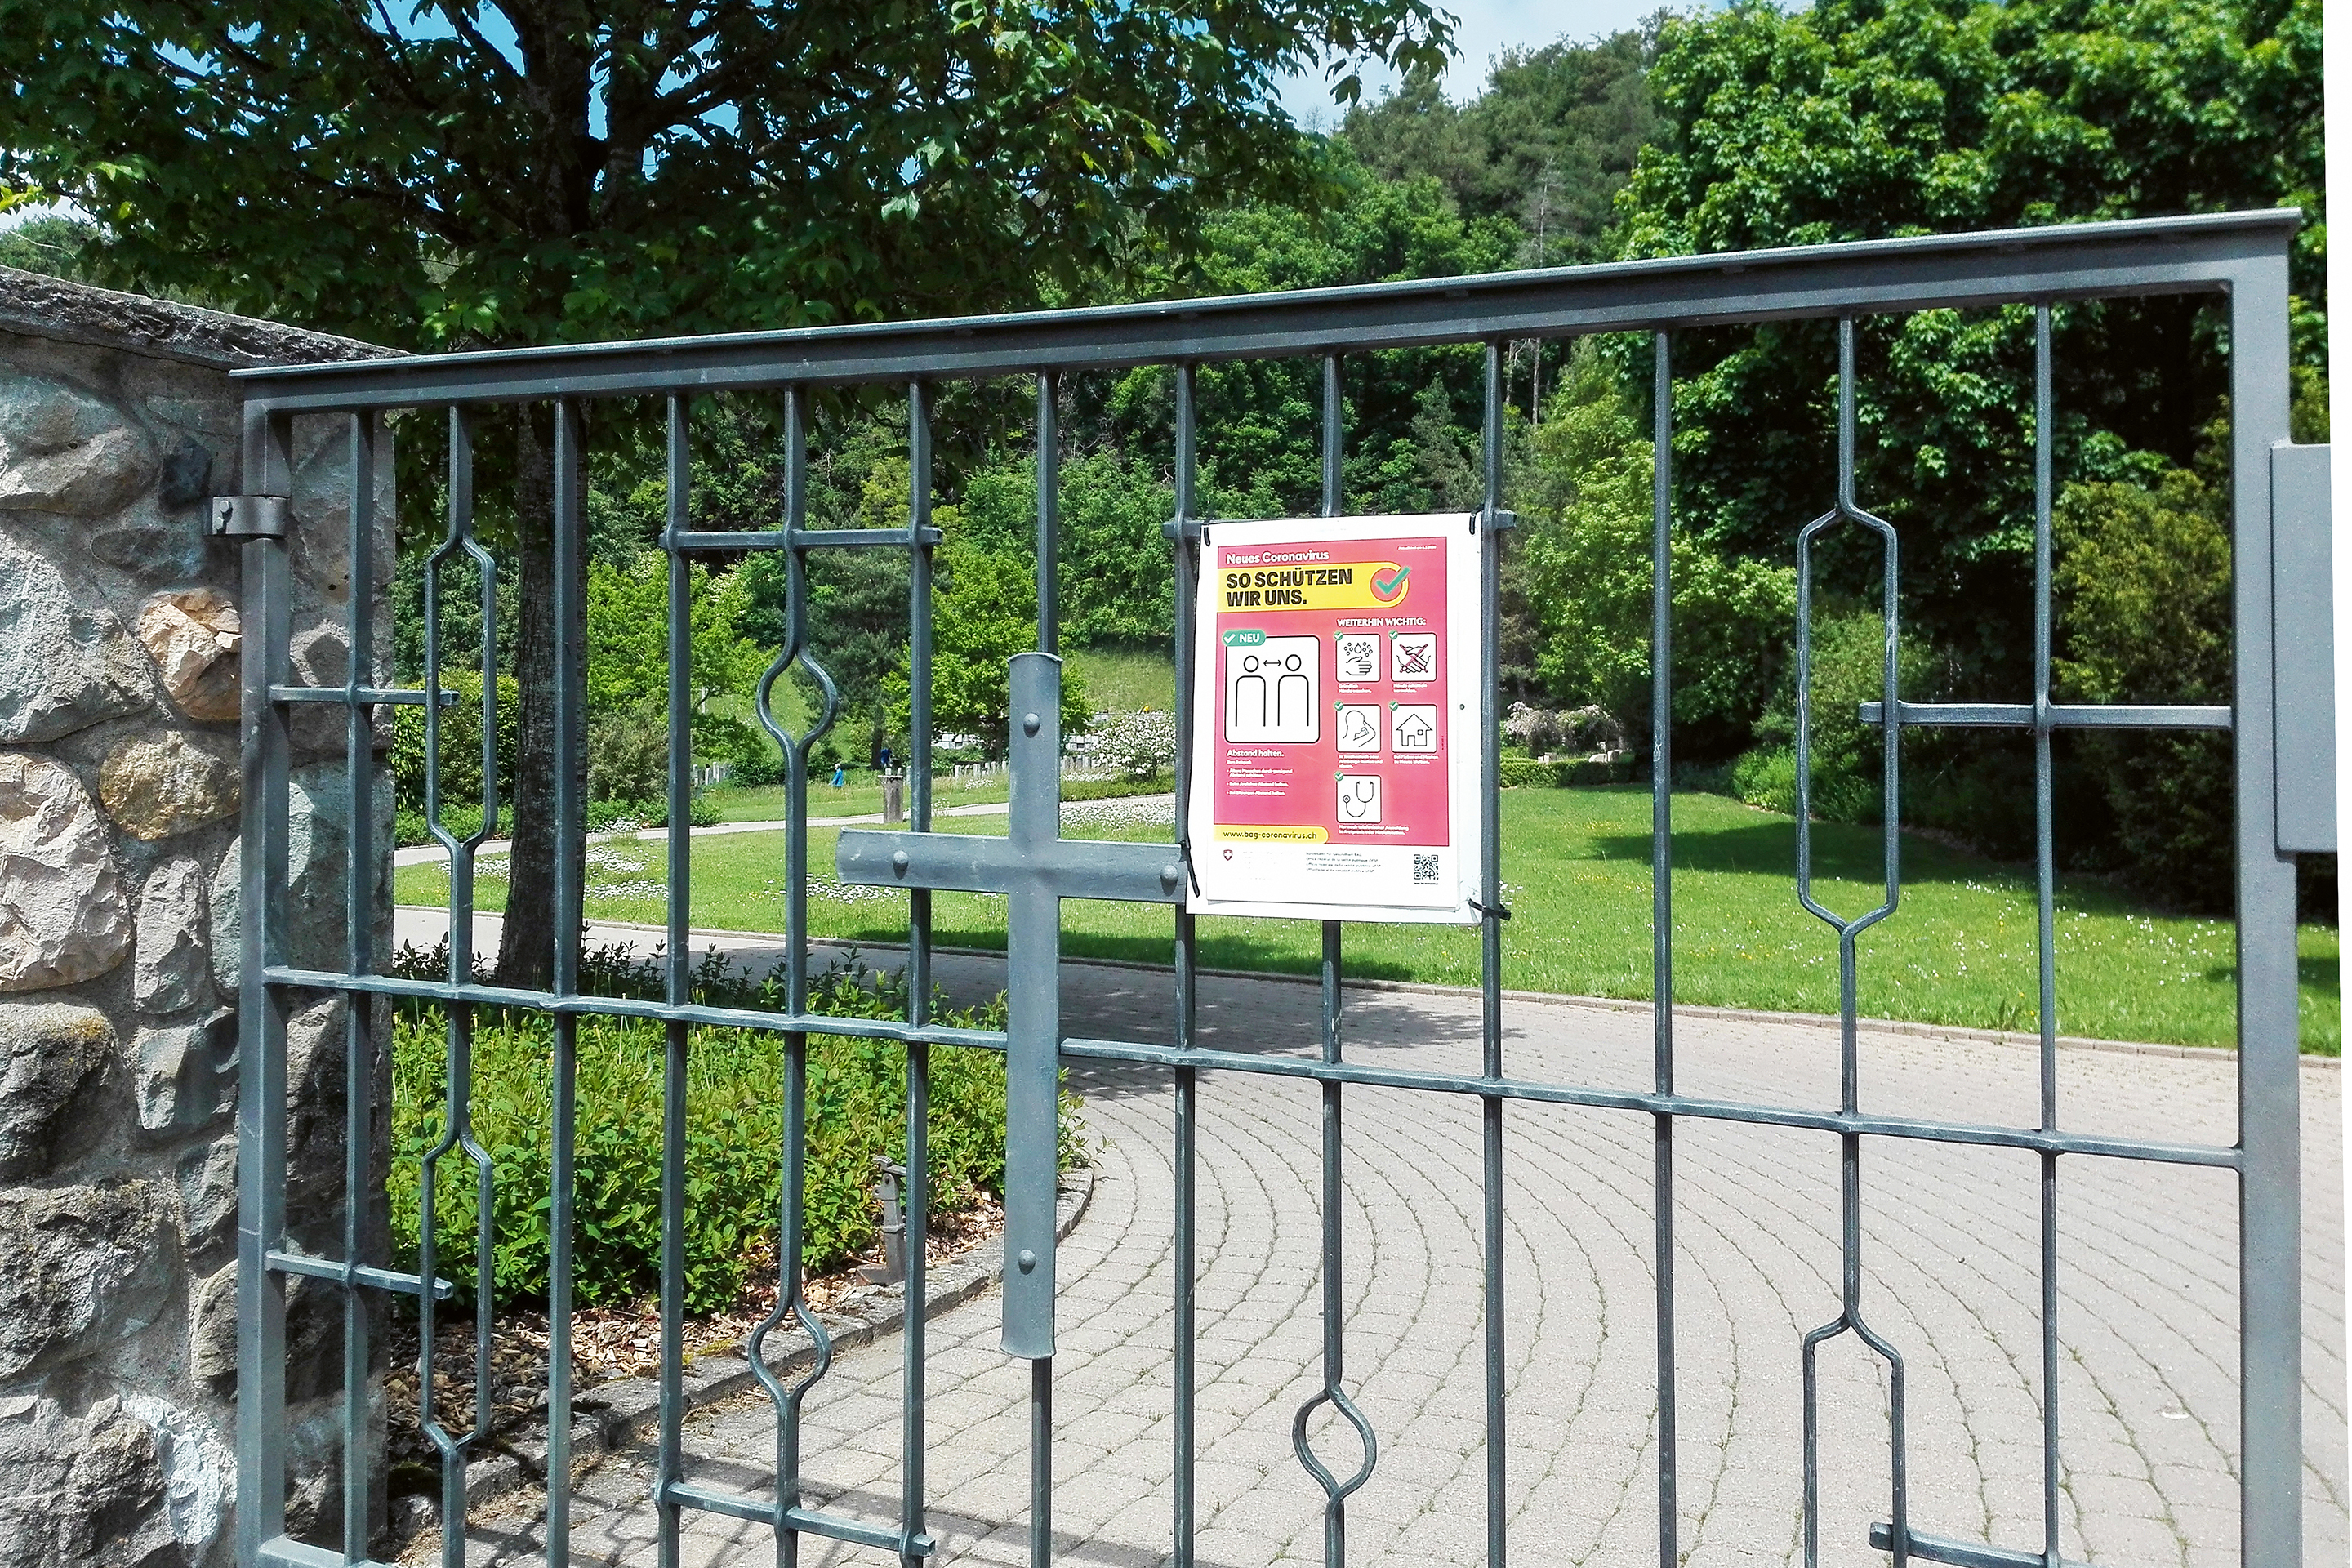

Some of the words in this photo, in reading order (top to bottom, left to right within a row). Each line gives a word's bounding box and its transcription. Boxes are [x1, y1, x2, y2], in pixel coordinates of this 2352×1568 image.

[1226, 553, 1260, 564] Neues
[1262, 550, 1330, 562] Coronavirus
[1227, 573, 1251, 589] SO
[1254, 567, 1352, 588] SCHÜTZEN
[1226, 590, 1261, 607] WIR
[1265, 589, 1307, 606] UNS.
[1337, 618, 1384, 627] WEITERHIN
[1385, 617, 1427, 626] WICHTIG:
[1239, 633, 1260, 644] NEU
[1227, 748, 1258, 757] Abstand
[1258, 748, 1285, 757] halten.
[1223, 830, 1317, 840] www.bag-coronavirus.ch
